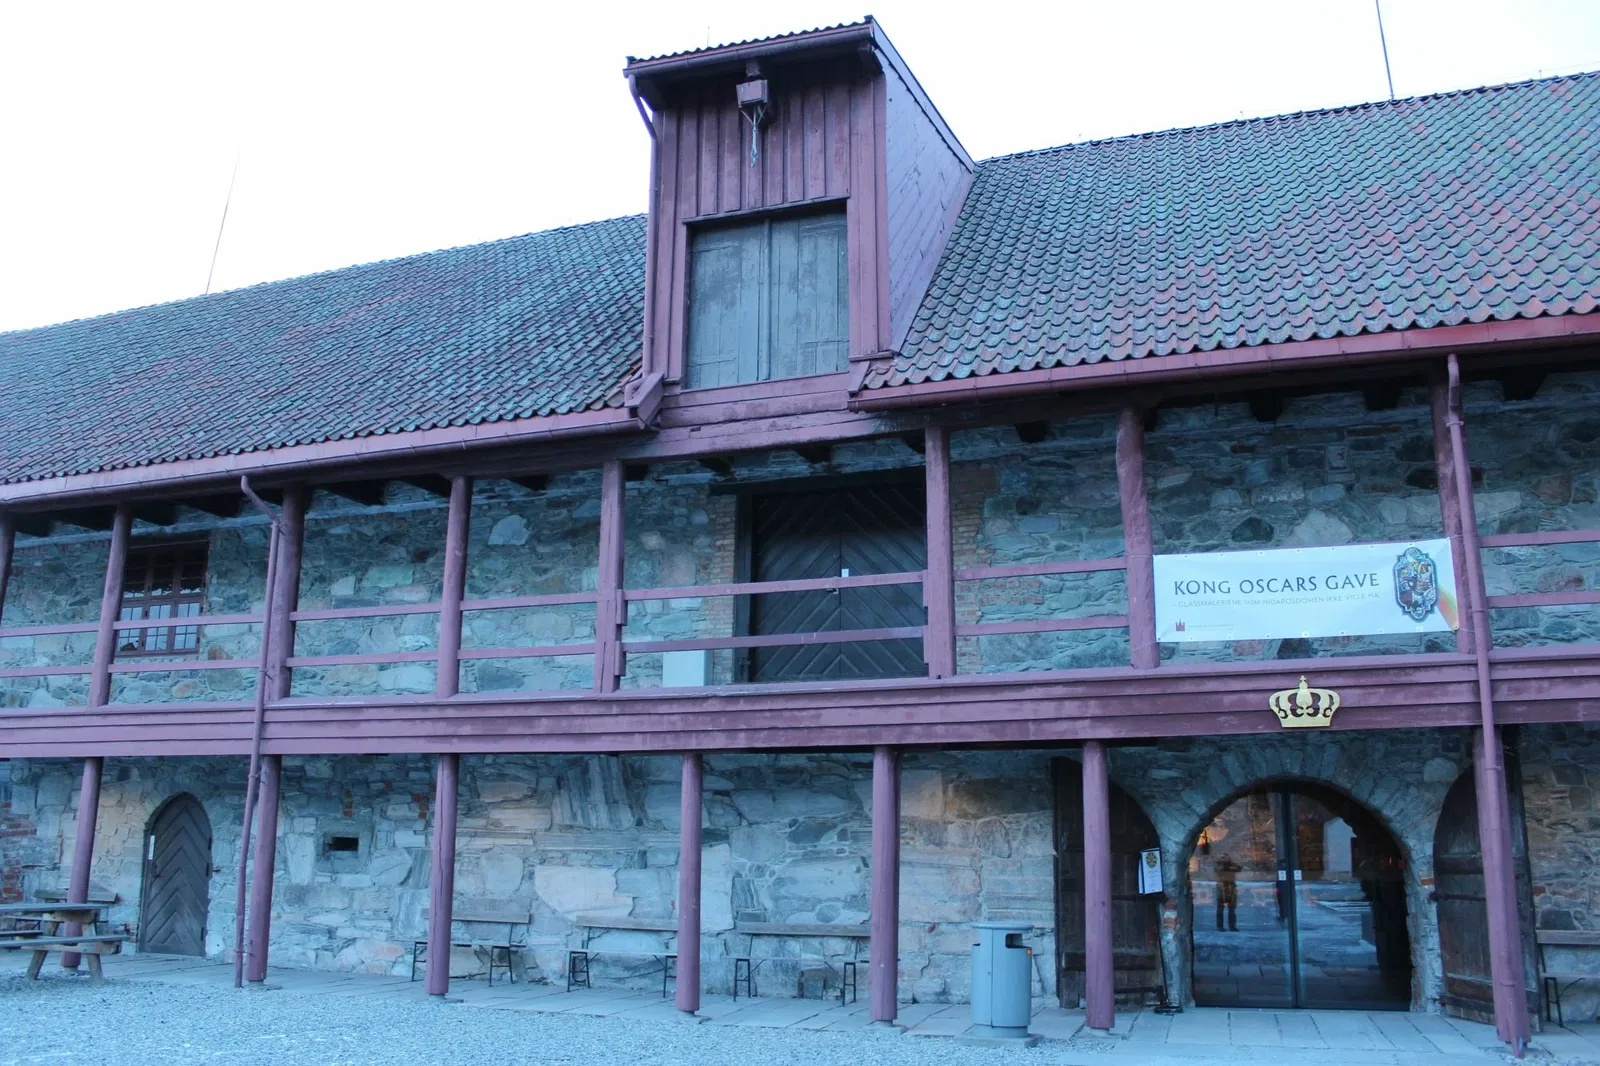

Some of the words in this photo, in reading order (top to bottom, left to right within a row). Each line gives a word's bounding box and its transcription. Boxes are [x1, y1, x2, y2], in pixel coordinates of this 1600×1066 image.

[1174, 580, 1231, 595] KONG
[1239, 576, 1317, 594] OSCARS
[1325, 572, 1380, 590] GAVE
[1244, 598, 1261, 606] SOM
[1327, 595, 1342, 603] IKKE
[1345, 593, 1366, 601] VILLE
